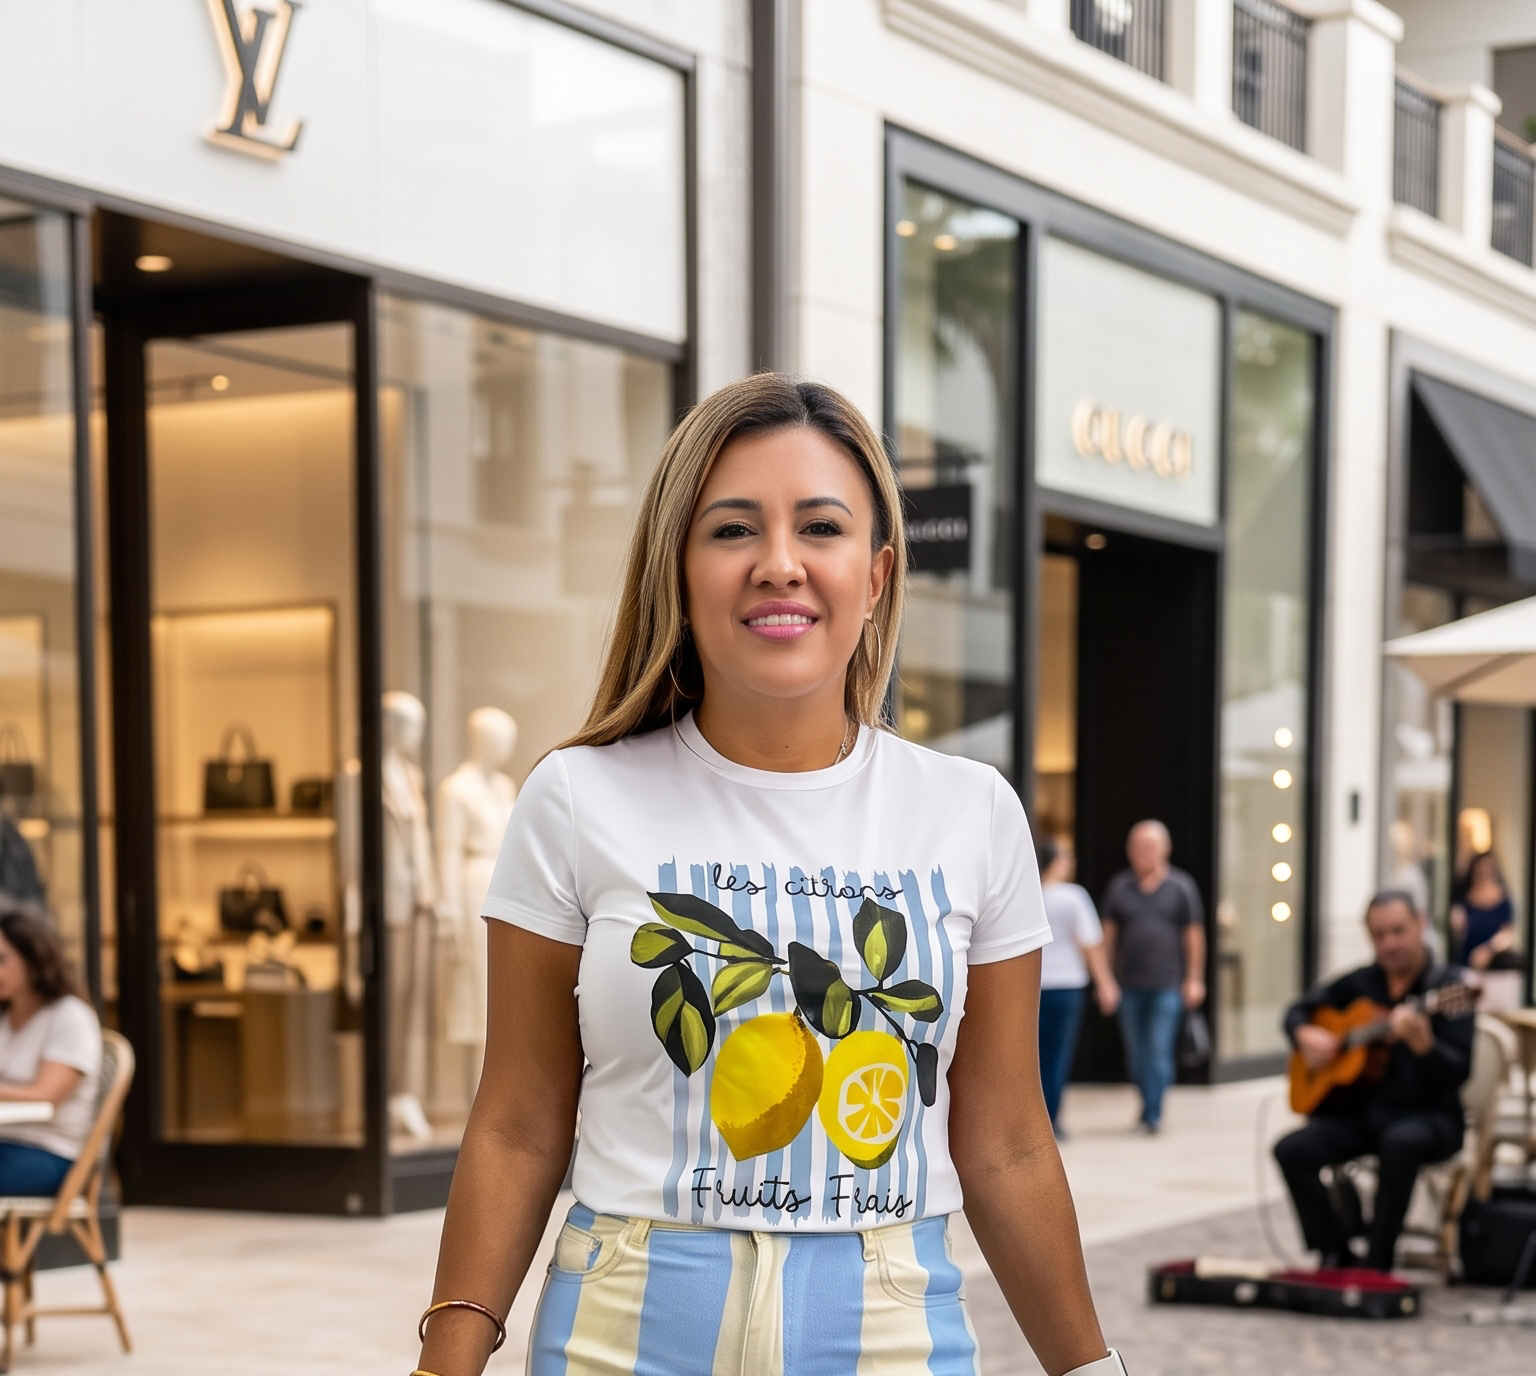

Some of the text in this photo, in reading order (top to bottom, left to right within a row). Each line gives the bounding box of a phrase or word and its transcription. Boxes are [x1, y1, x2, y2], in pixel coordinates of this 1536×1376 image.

[711, 863, 904, 901] les citrons
[691, 1167, 913, 1219] Fruits Frais
